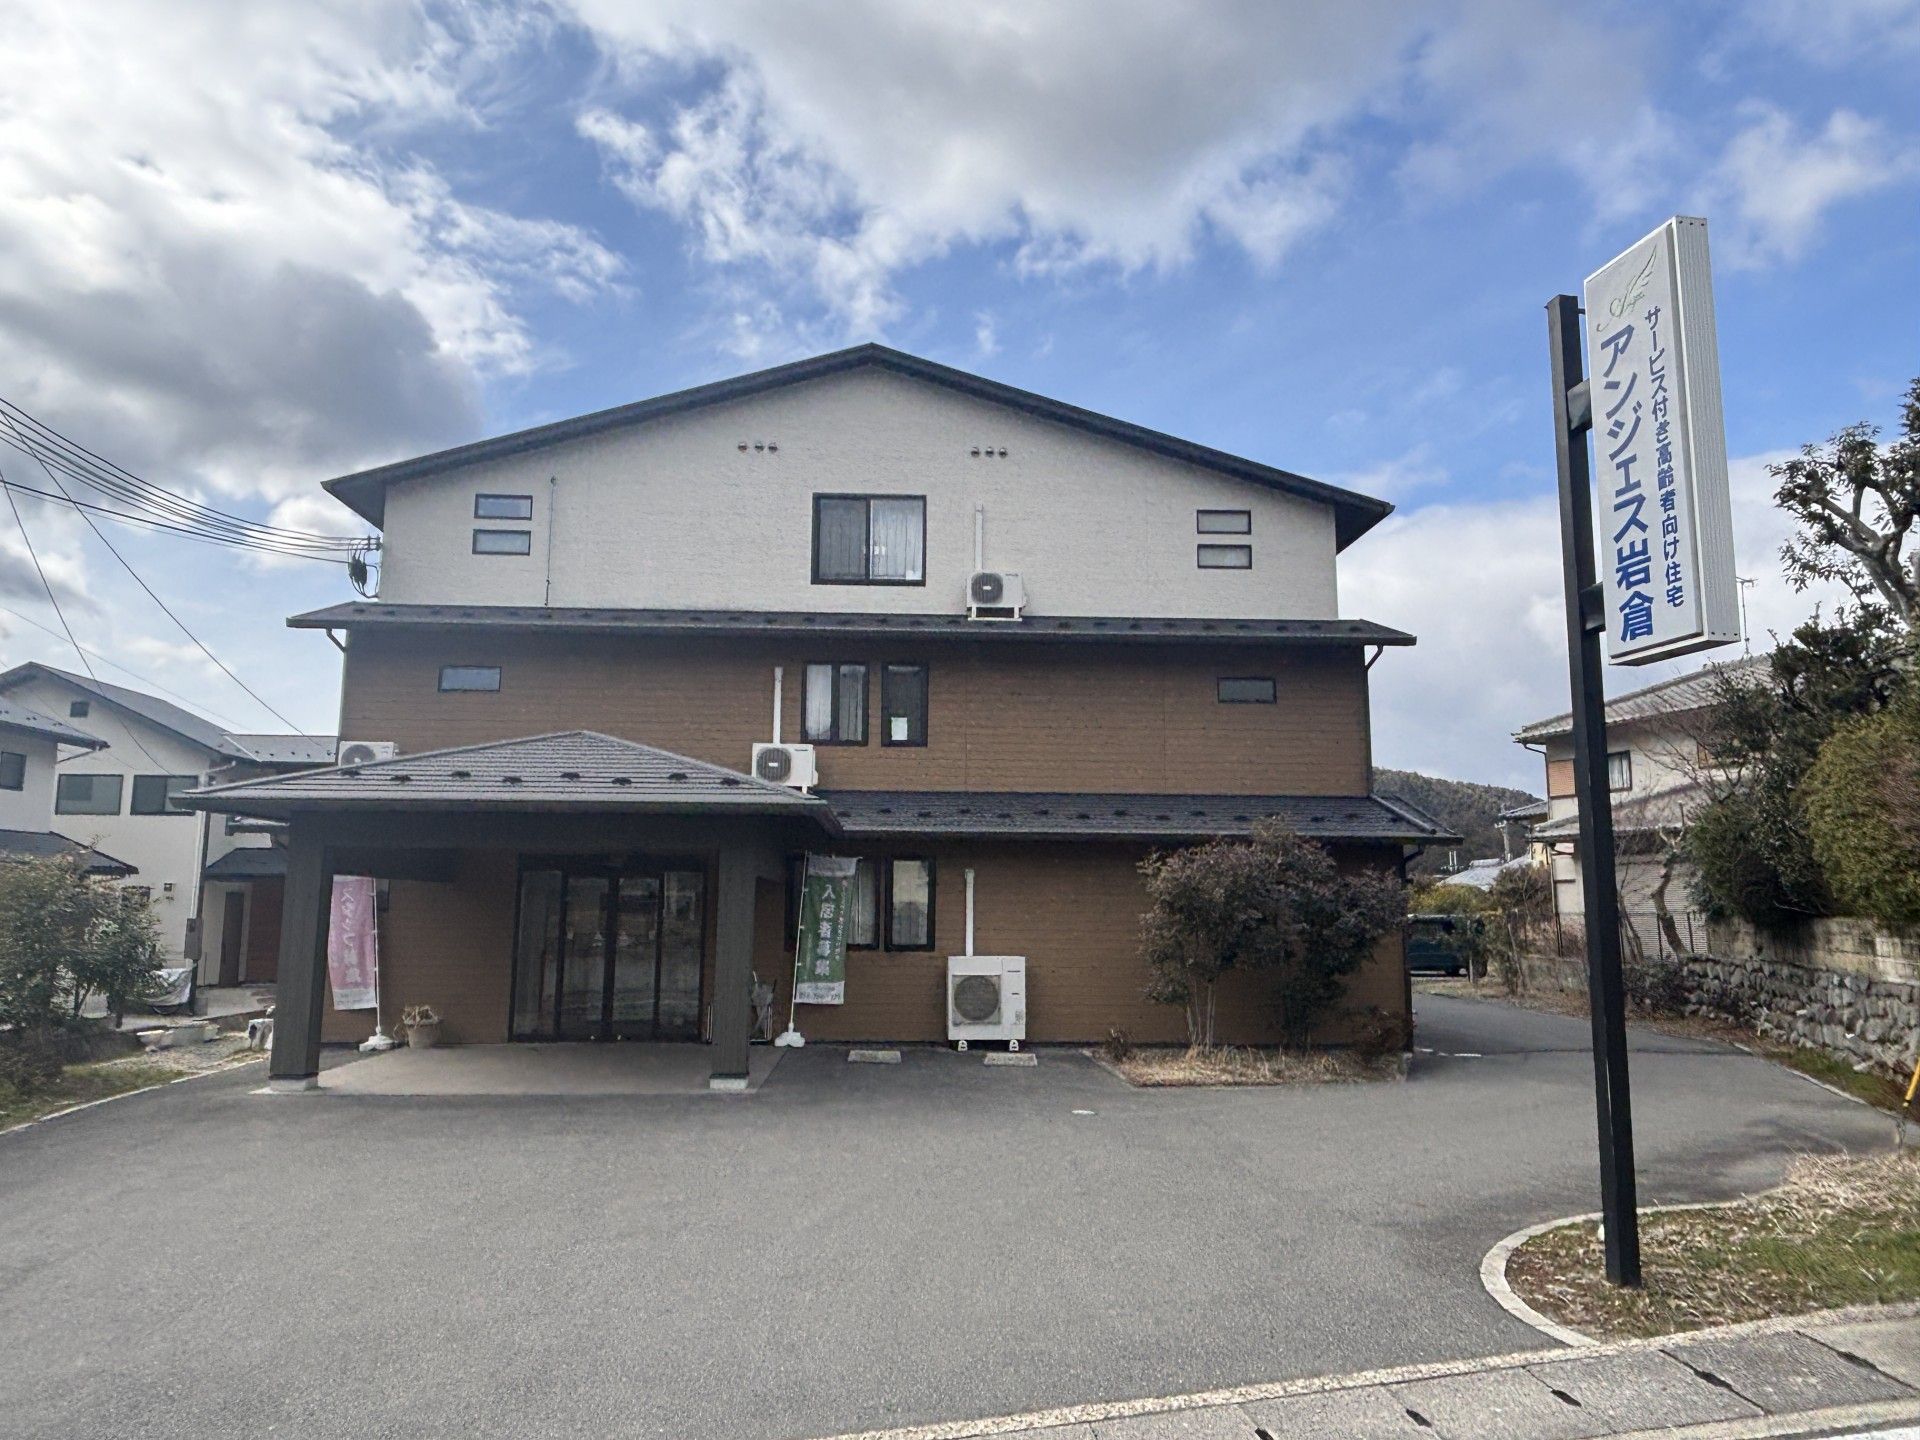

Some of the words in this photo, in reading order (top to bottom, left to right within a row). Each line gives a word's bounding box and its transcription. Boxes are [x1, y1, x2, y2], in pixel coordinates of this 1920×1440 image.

[1600, 324, 1655, 642] アンジェス岩倉
[1644, 306, 1685, 607] サービス付き高齢者向け住宅
